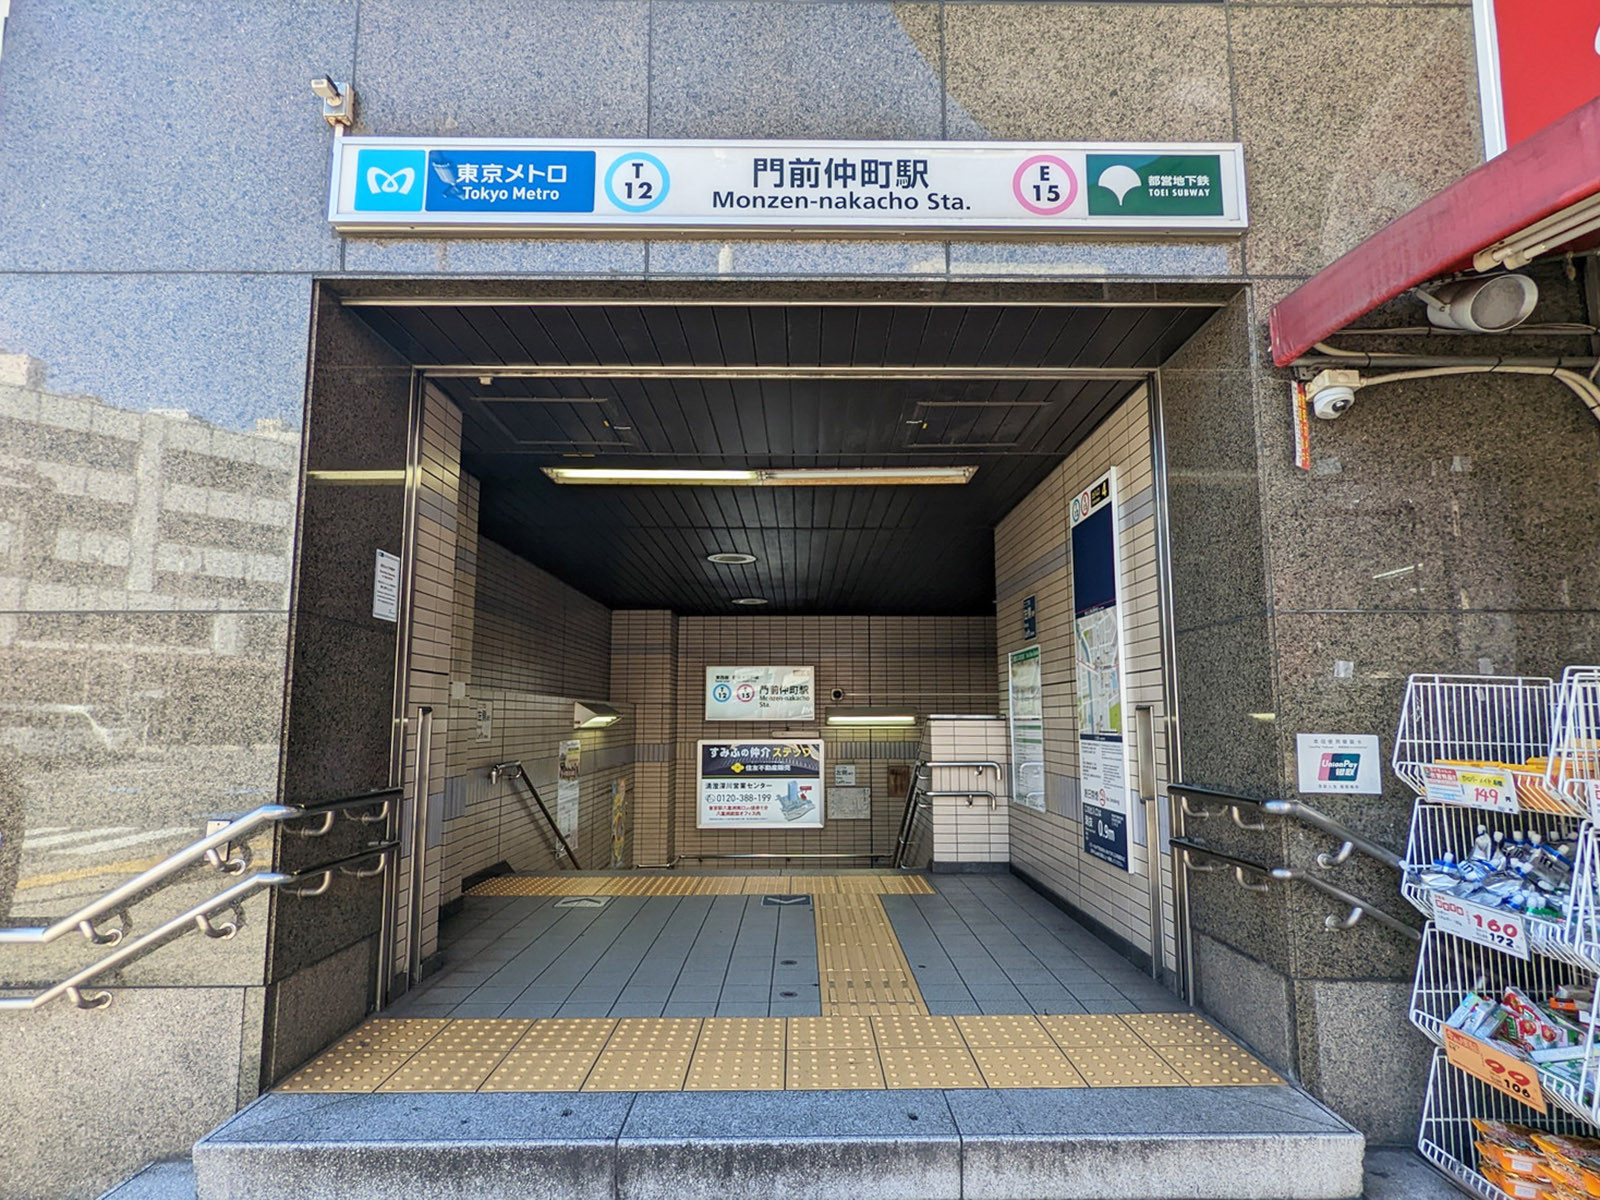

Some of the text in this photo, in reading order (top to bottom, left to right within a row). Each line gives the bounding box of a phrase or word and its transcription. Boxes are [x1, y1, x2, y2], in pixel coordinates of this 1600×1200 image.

[456, 163, 567, 183] 東京メトロ
[632, 163, 643, 178] T
[753, 158, 929, 189] 門前仲町駅
[1040, 165, 1050, 181] E
[1148, 175, 1210, 186] 都営地下鉄
[463, 187, 559, 202] Tokyo Metro
[625, 182, 652, 199] 12
[1033, 185, 1060, 202] 15
[713, 191, 971, 210] Monzen-nakacho Sta.
[1102, 481, 1107, 496] 4
[760, 685, 809, 694] 門前仲町駅
[709, 747, 771, 758] すみふの仲介
[1322, 759, 1357, 773] UnionPay
[716, 793, 771, 802] 0120-388-199
[1474, 787, 1498, 805] 149
[1098, 819, 1115, 842] 0.9m
[1473, 914, 1518, 938] 160
[1489, 933, 1514, 948] 172
[1484, 1059, 1530, 1086] 99
[1504, 1079, 1531, 1098] 106
